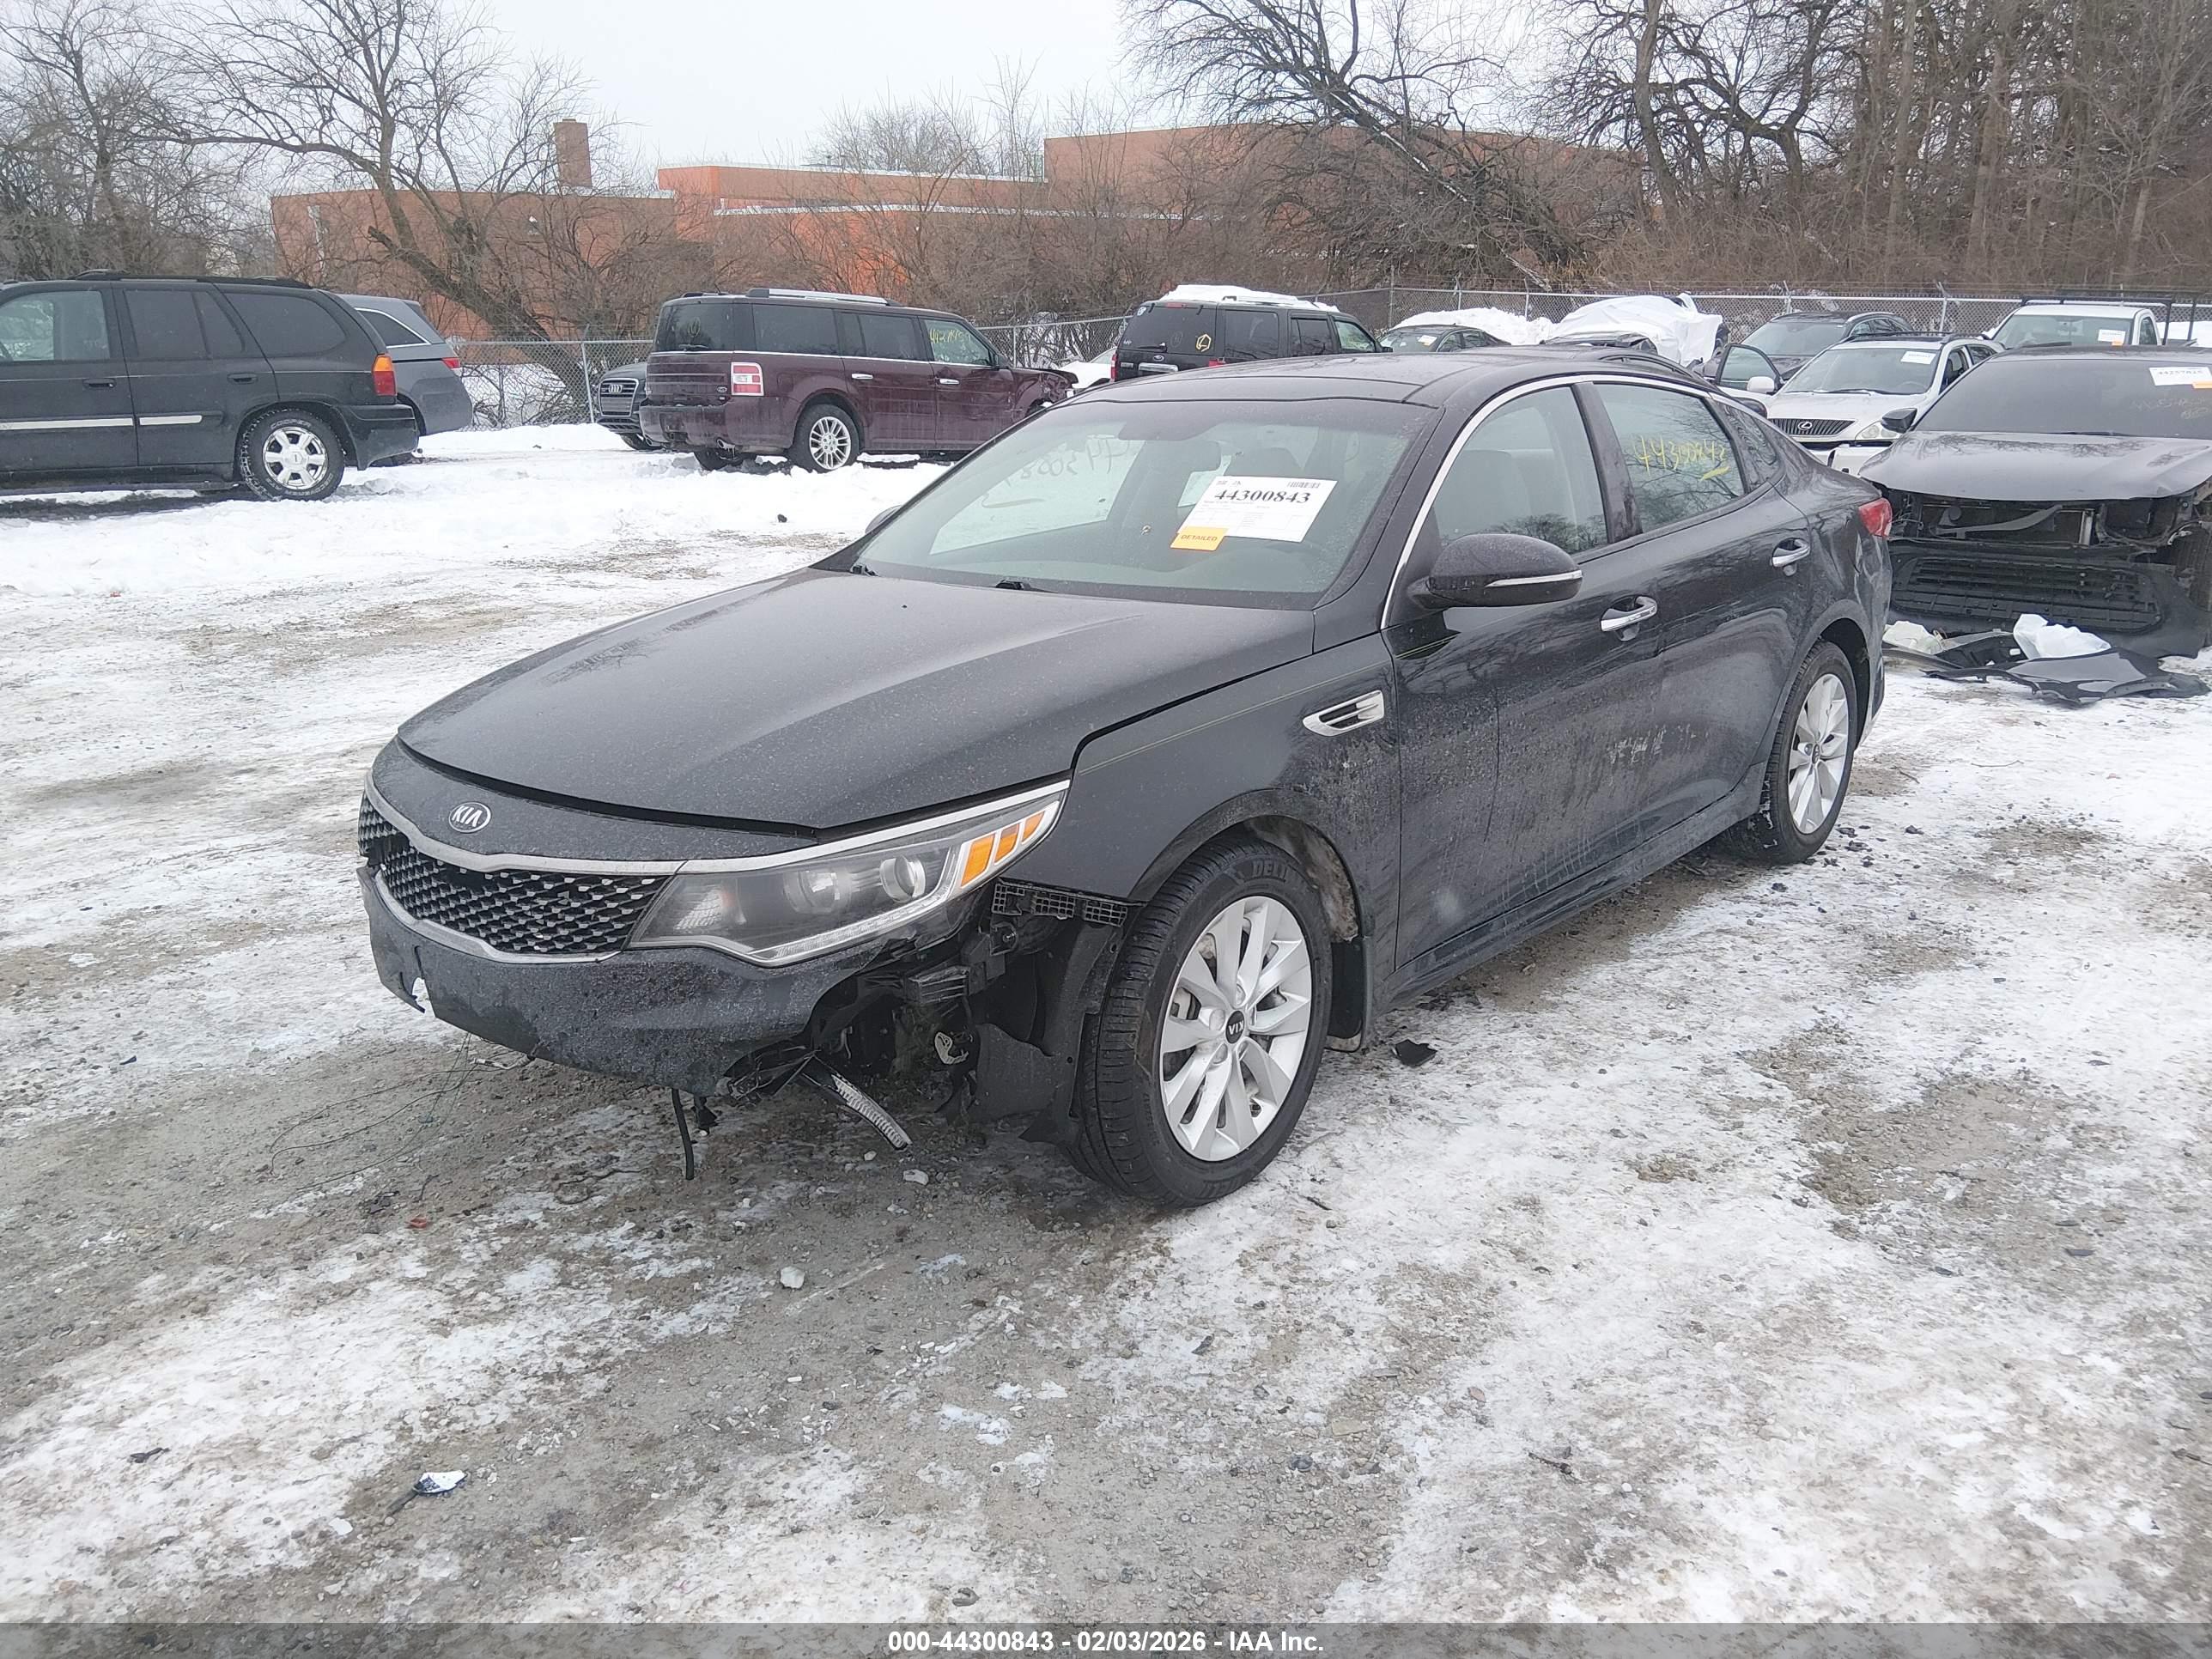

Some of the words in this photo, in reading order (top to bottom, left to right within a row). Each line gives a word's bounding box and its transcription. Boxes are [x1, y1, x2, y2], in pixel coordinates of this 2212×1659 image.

[1214, 489, 1312, 504] 44300843
[452, 805, 483, 828] KIA
[1228, 1020, 1244, 1036] KIA
